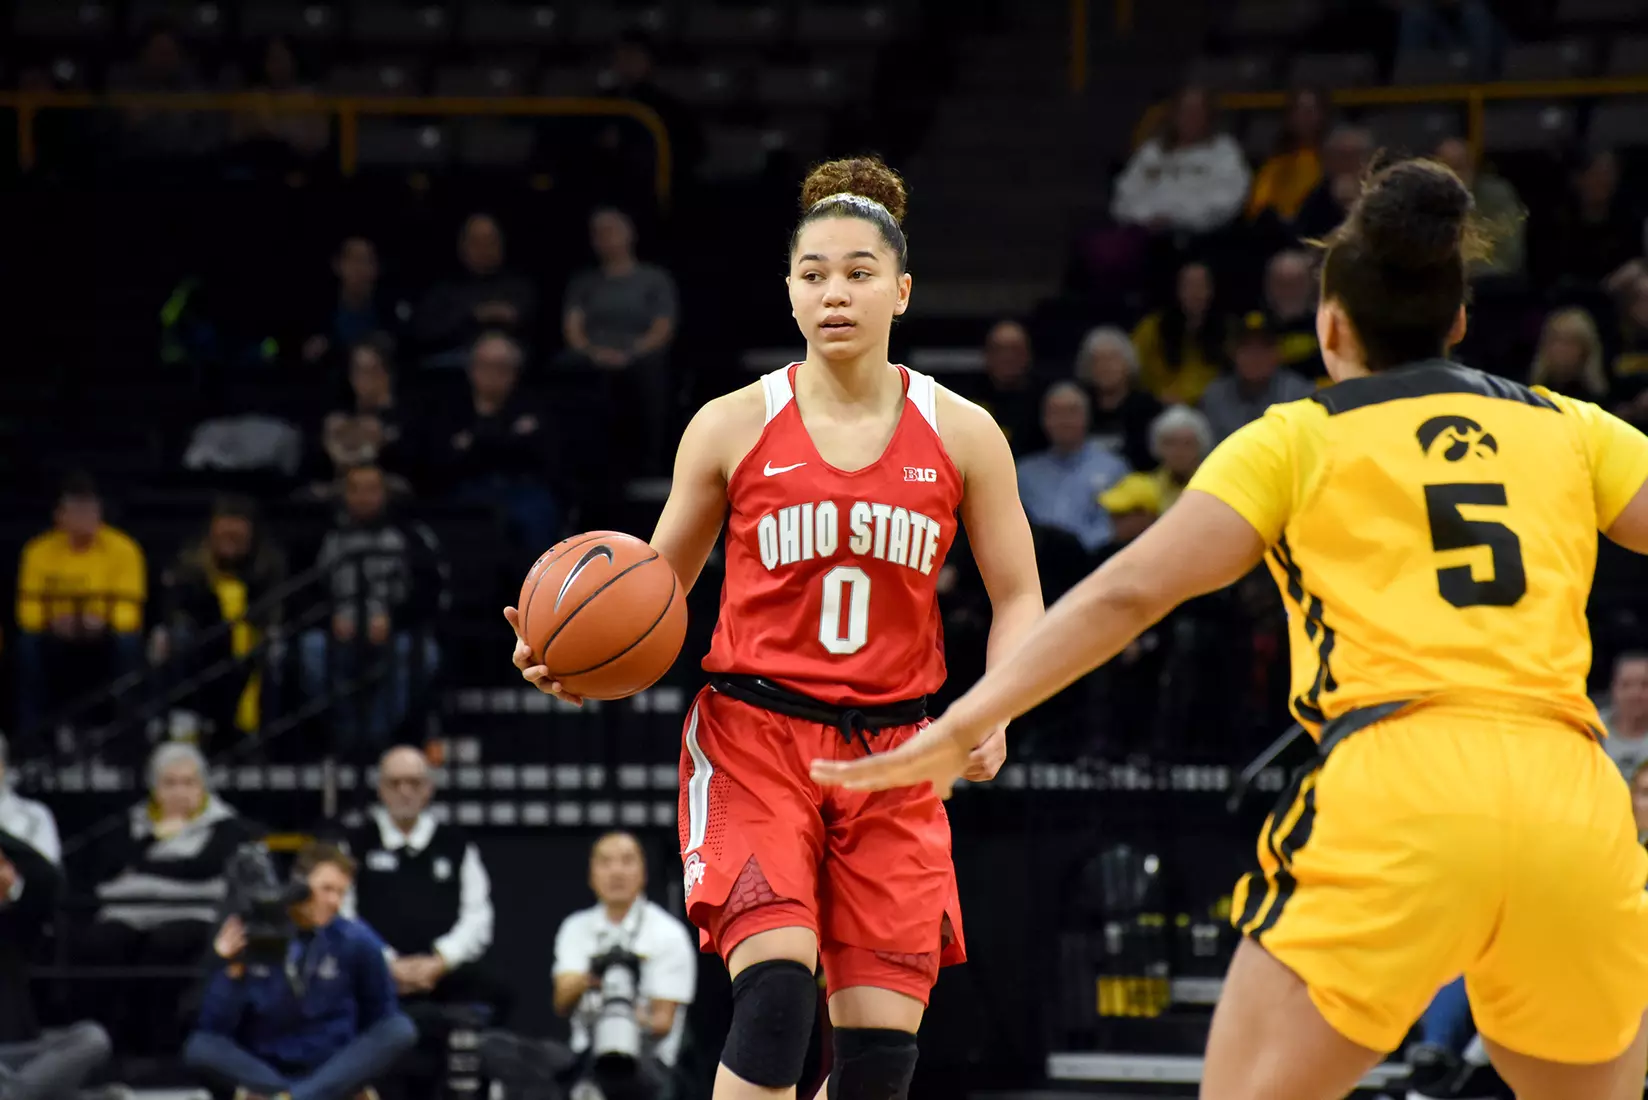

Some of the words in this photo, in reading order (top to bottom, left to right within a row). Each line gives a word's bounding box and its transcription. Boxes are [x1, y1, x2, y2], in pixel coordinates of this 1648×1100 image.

[757, 500, 839, 571] OHIO
[848, 501, 941, 576] STATE
[1423, 483, 1527, 609] 5
[818, 566, 871, 655] 0
